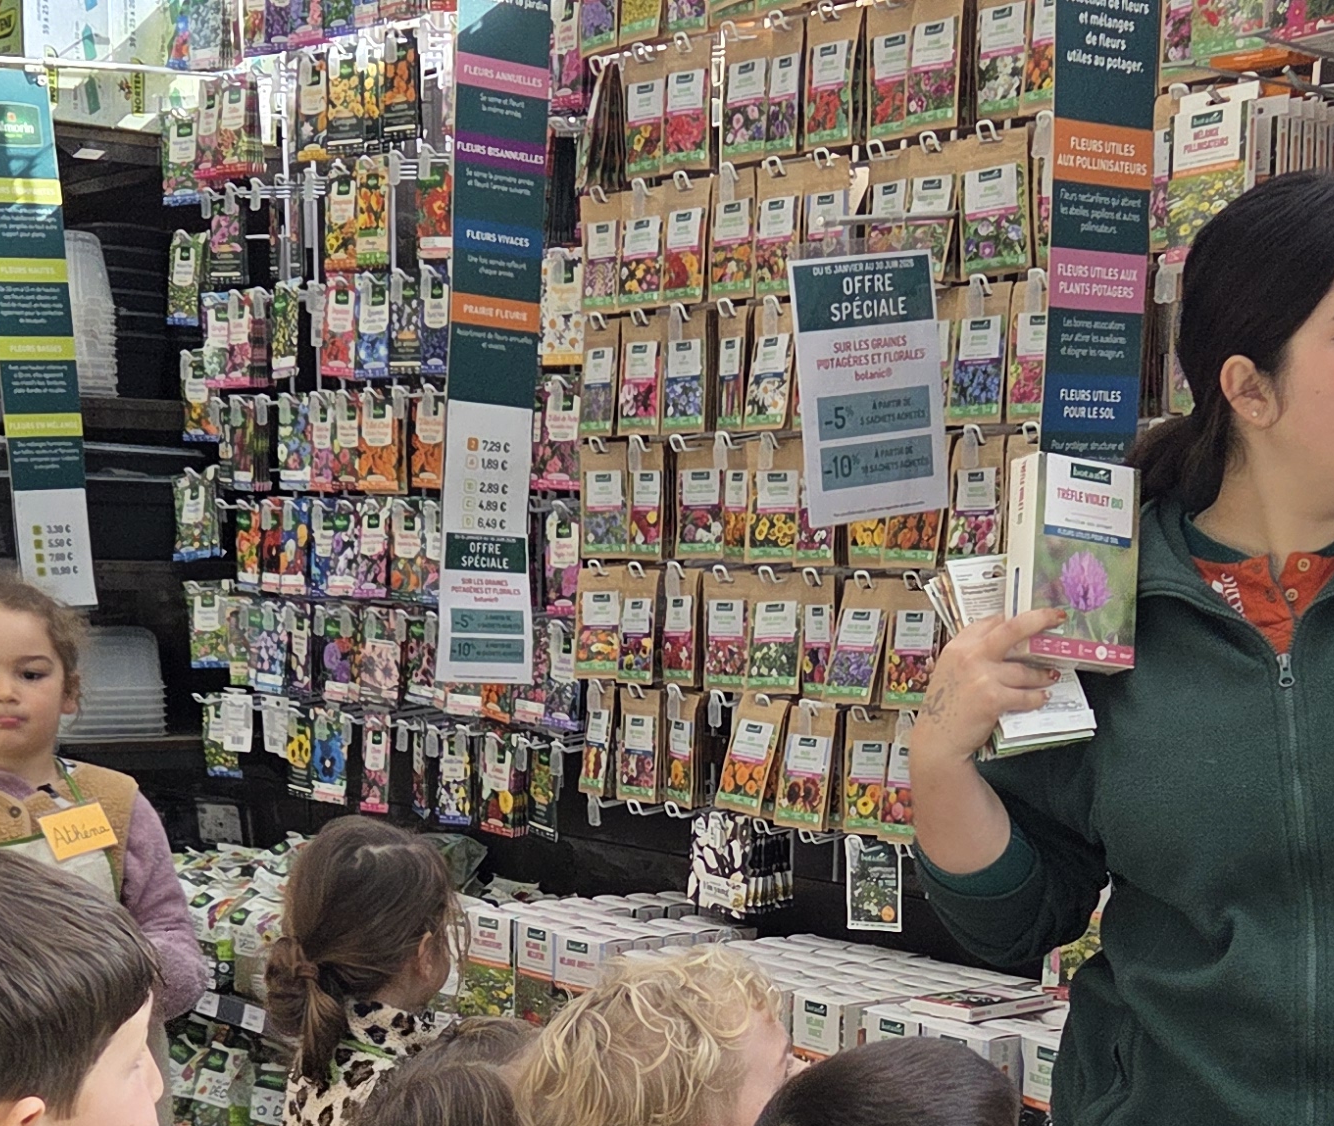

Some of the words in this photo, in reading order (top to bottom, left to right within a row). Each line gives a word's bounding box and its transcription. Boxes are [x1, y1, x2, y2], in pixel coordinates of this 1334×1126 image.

[1079, 13, 1089, 24] et
[1090, 14, 1134, 33] mélanges
[1086, 32, 1097, 45] de
[1099, 33, 1126, 50] fleurs
[1067, 49, 1092, 66] utiles
[1094, 55, 1105, 66] au
[464, 64, 494, 79] FLEURS
[496, 71, 542, 88] ANNUELLES
[457, 141, 486, 155] FLEURS
[488, 147, 544, 164] BISANNUELLES
[1070, 136, 1103, 153] FLEURS
[1105, 143, 1135, 157] UTILES
[1057, 154, 1074, 167] AUX
[1075, 156, 1147, 176] POLLINISATEURS
[466, 229, 496, 242] FLEURS
[498, 234, 529, 247] VIVACES
[813, 267, 823, 276] DU
[825, 266, 832, 274] 15
[834, 263, 863, 274] JANVIER
[865, 262, 874, 271] AU
[884, 260, 898, 269] JUIN
[1057, 264, 1088, 278] FLEURS
[1089, 266, 1118, 280] UTILES
[1120, 268, 1137, 282] AUX
[843, 274, 893, 295] OFFRE
[1059, 281, 1090, 296] PLANTS
[1091, 283, 1134, 299] POTAGERS
[463, 304, 493, 317] PRAIRIE
[495, 308, 528, 321] FLEURIE
[831, 297, 907, 322] SPÉCIALE
[834, 342, 852, 353] SUR
[854, 340, 869, 351] LES
[871, 336, 907, 349] GRAINES
[817, 354, 869, 370] POTAGÈRES
[871, 353, 882, 365] ET
[884, 349, 925, 363] FLORALES
[1060, 388, 1091, 402] FLEURS
[1093, 389, 1121, 402] UTILES
[1064, 406, 1086, 418] POUR
[1087, 406, 1099, 418] LE
[1100, 407, 1115, 419] SOL
[503, 443, 510, 453] €
[501, 460, 508, 471] €
[1073, 466, 1109, 482] botanic
[479, 482, 499, 493] 2,89
[502, 484, 508, 495] €
[1057, 486, 1083, 502] TRÈFLE
[1085, 492, 1110, 506] VIOLET
[478, 501, 498, 512] 4,89
[500, 502, 506, 512] €
[478, 518, 497, 529] 6,49
[499, 520, 506, 529] €
[470, 542, 501, 554] OFFRE
[461, 553, 509, 569] SPÉCIALE
[52, 821, 112, 846] Athéna
